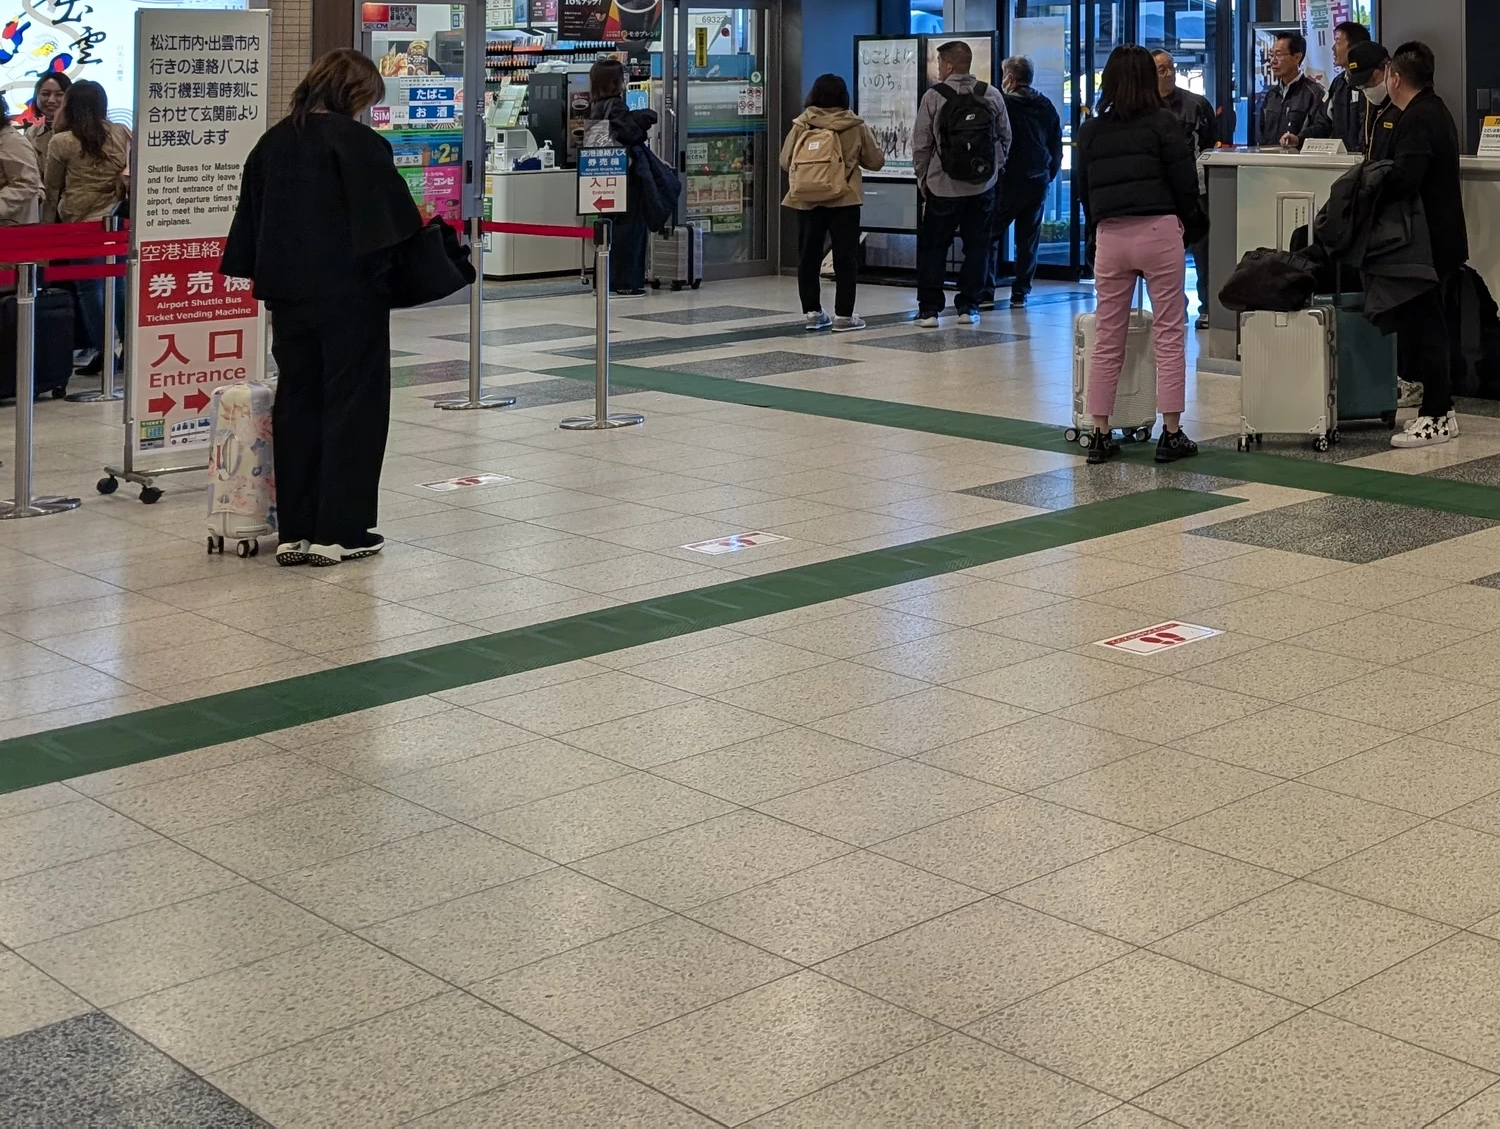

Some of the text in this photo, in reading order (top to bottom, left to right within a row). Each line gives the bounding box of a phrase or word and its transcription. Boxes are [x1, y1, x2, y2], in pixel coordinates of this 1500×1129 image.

[150, 34, 260, 51] 松江市内・出雲市内
[150, 58, 259, 75] 行きの連絡バスは
[862, 72, 902, 91] いのち。
[148, 82, 258, 99] 飛行機到着時刻に
[416, 89, 448, 100] たばこ
[148, 105, 258, 123] 合わせて玄関前より
[374, 112, 390, 121] SIM
[416, 107, 448, 118] お酒
[148, 129, 230, 147] 出発致します
[580, 149, 626, 157] 空港連絡バス
[148, 165, 174, 173] Shuttle
[176, 164, 198, 172] Buses
[202, 163, 212, 171] for
[214, 163, 240, 171] Matsue
[588, 157, 620, 167] 券売機
[148, 176, 160, 184] and
[164, 175, 174, 183] for
[178, 175, 198, 183] Izumo
[202, 174, 214, 183] city
[218, 173, 236, 181] leave
[590, 177, 616, 187] 入口
[148, 187, 158, 195] the
[182, 185, 214, 193] entrance
[227, 183, 238, 191] the
[146, 197, 172, 206] airport,
[176, 195, 210, 205] departure
[172, 207, 190, 215] meet
[208, 205, 229, 213] arrival
[146, 218, 192, 227] of airplanes.
[142, 241, 224, 262] 空港連絡
[148, 271, 251, 299] 券売機
[157, 296, 242, 310] Airport Shuttle Bus
[146, 307, 251, 322] Ticket Vending Machine
[150, 329, 244, 368] 入口
[150, 366, 246, 389] Entrance
